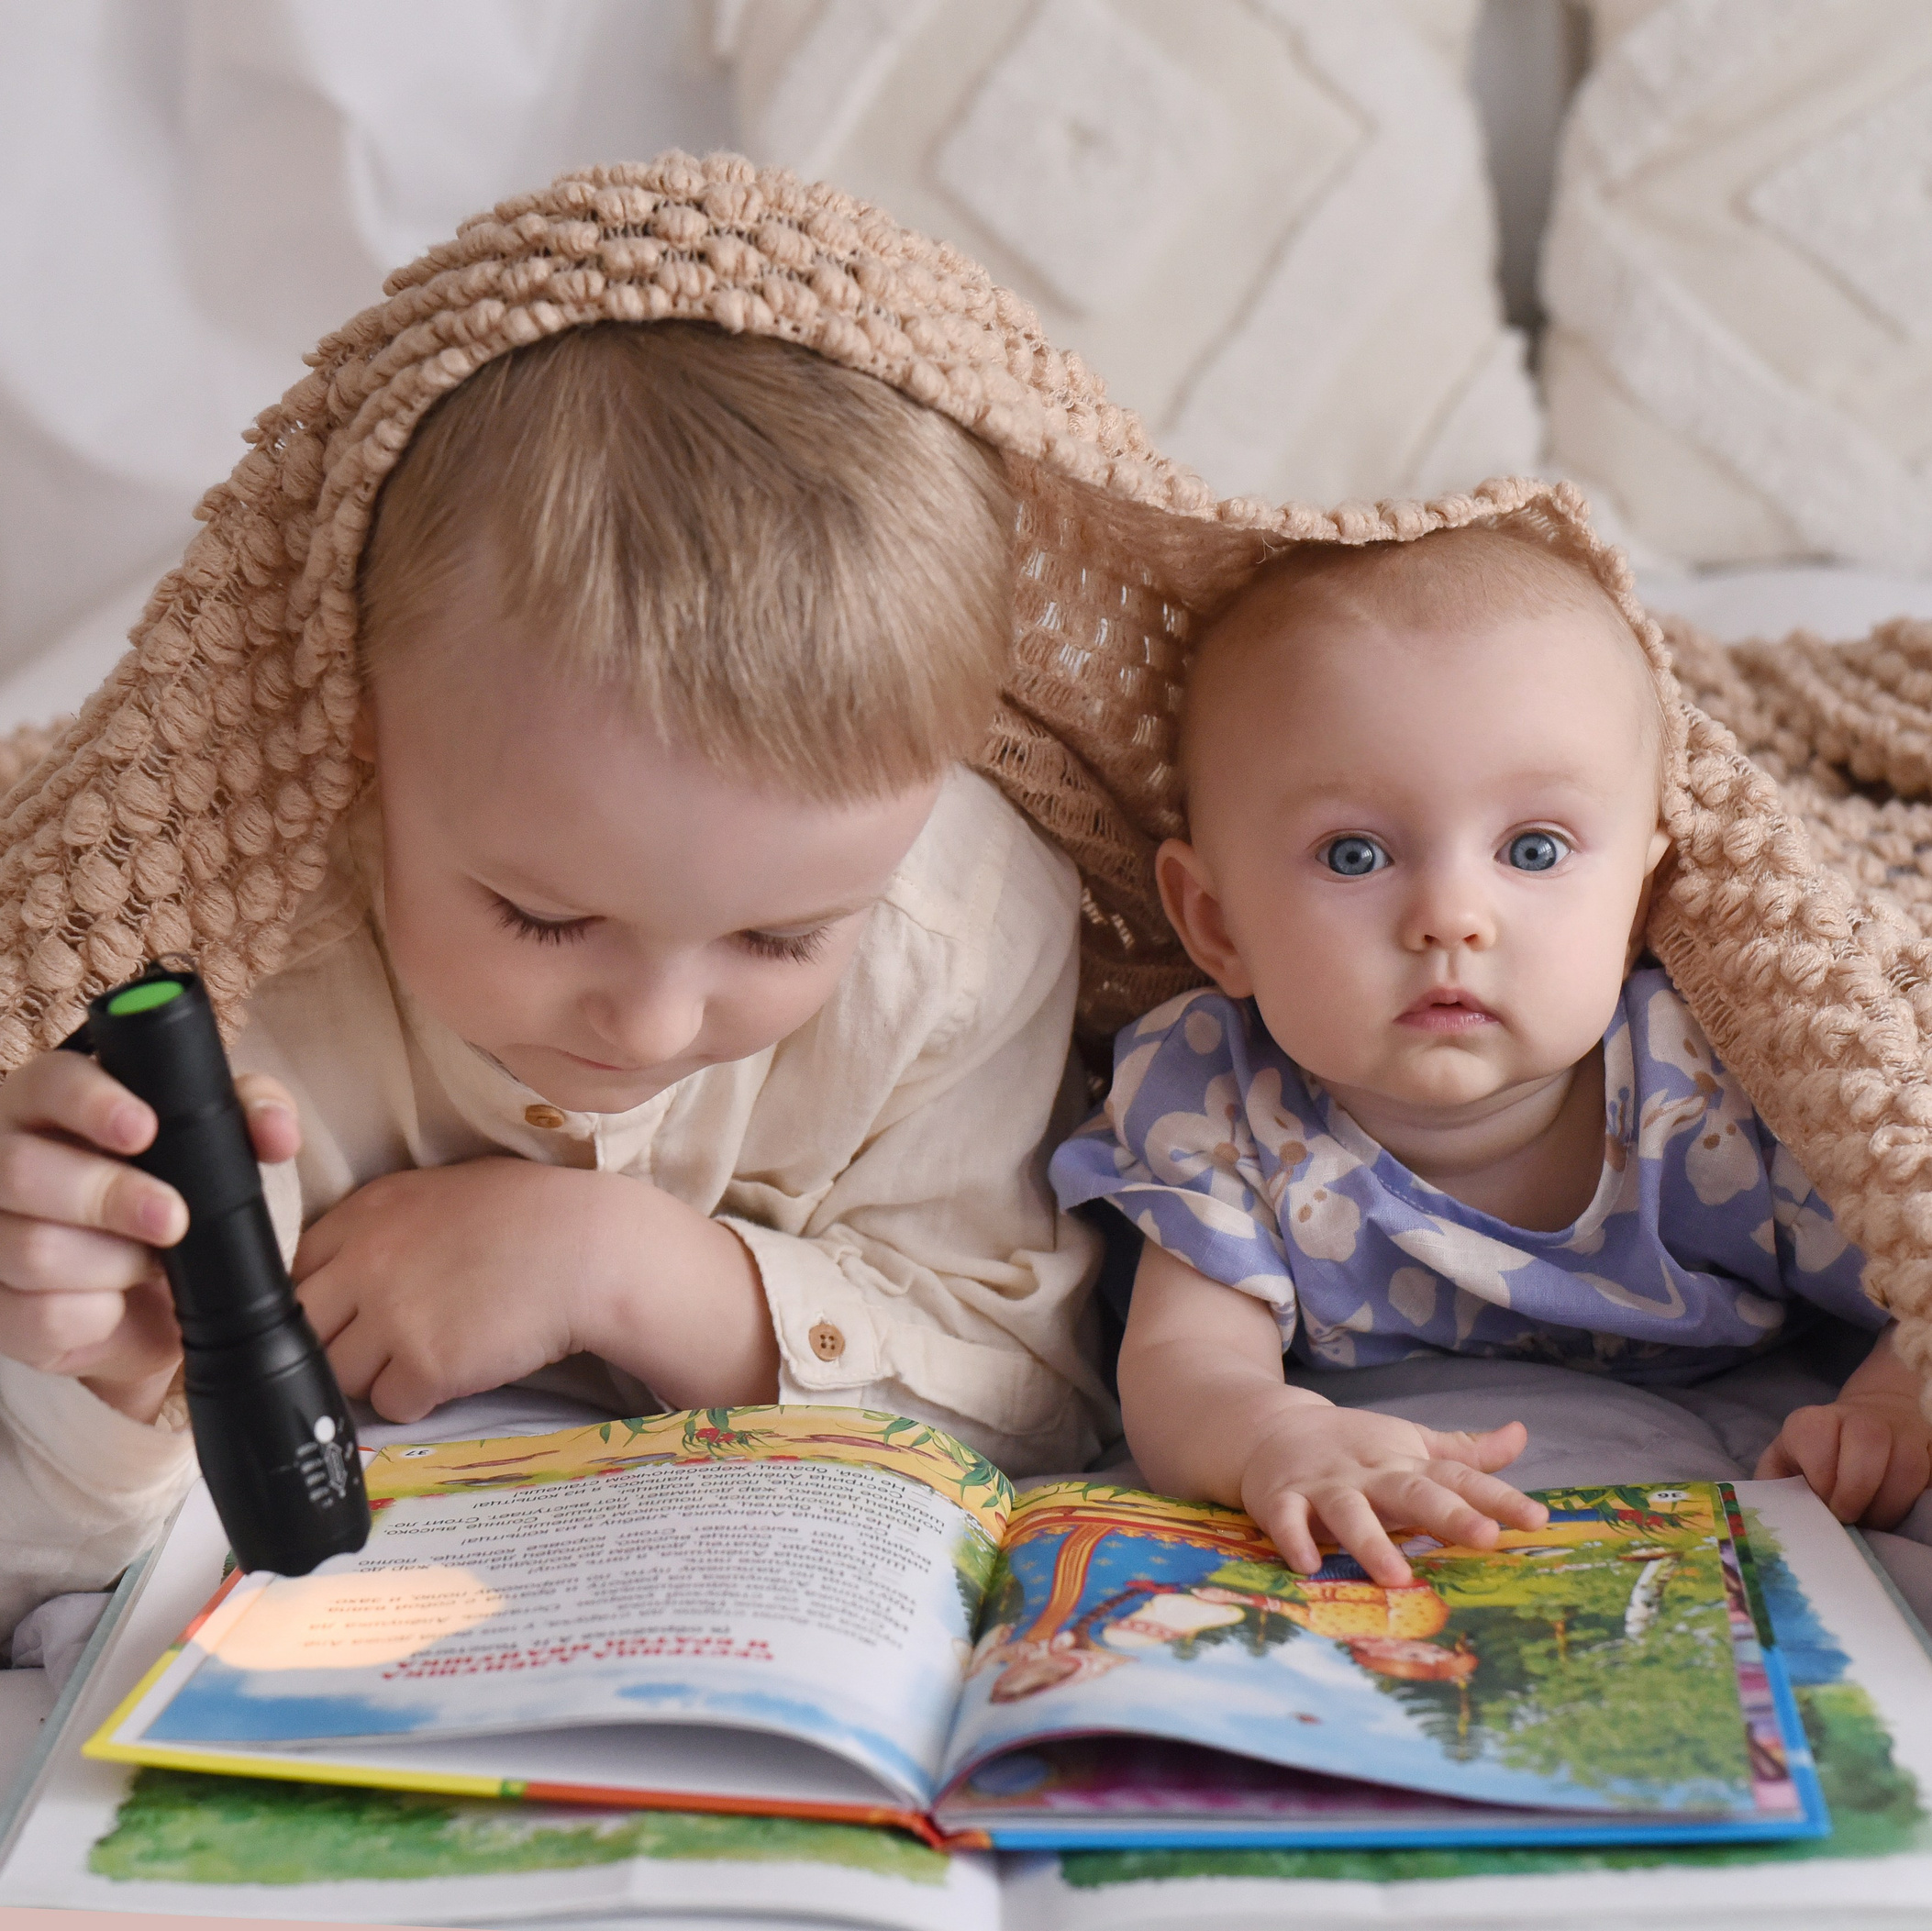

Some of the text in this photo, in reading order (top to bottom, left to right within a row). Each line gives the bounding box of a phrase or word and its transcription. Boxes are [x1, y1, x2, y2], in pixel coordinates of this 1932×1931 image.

[605, 1465, 748, 1484] жеребёночком
[698, 1470, 802, 1482] Алёнушка,
[756, 1463, 827, 1477] братец,
[836, 1469, 873, 1482] пей,
[514, 1480, 600, 1501] станешь!
[608, 1476, 690, 1491] напьюсь
[617, 1482, 694, 1495] водицы.
[767, 1478, 853, 1493] копытце,
[809, 1474, 902, 1503] Сестрица
[882, 1479, 905, 1495] Не
[636, 1487, 734, 1501] донимает,
[716, 1493, 841, 1507] послушался,
[785, 1487, 861, 1503] далеко,
[1657, 1492, 1682, 1500] 36
[472, 1493, 558, 1511] копытца!
[594, 1497, 627, 1506] пот
[638, 1496, 703, 1507] пошли
[737, 1501, 811, 1514] братец,
[861, 1490, 944, 1527] шадиное
[488, 1502, 590, 1521] выступает.
[612, 1504, 727, 1518] телёночком
[678, 1508, 784, 1519] Алёнушка,
[820, 1506, 858, 1519] пей,
[866, 1497, 941, 1536] колодец
[422, 1517, 479, 1527] Стоит
[466, 1516, 538, 1530] Солнце
[517, 1515, 605, 1534] станешь!
[600, 1514, 669, 1527] хлебну
[792, 1511, 888, 1540] Сестрица
[852, 1503, 919, 1535] Братец
[866, 1516, 891, 1532] Не
[383, 1526, 457, 1535] высоко,
[555, 1525, 576, 1533] из
[461, 1529, 549, 1547] копытца!
[430, 1548, 516, 1561] копытце,
